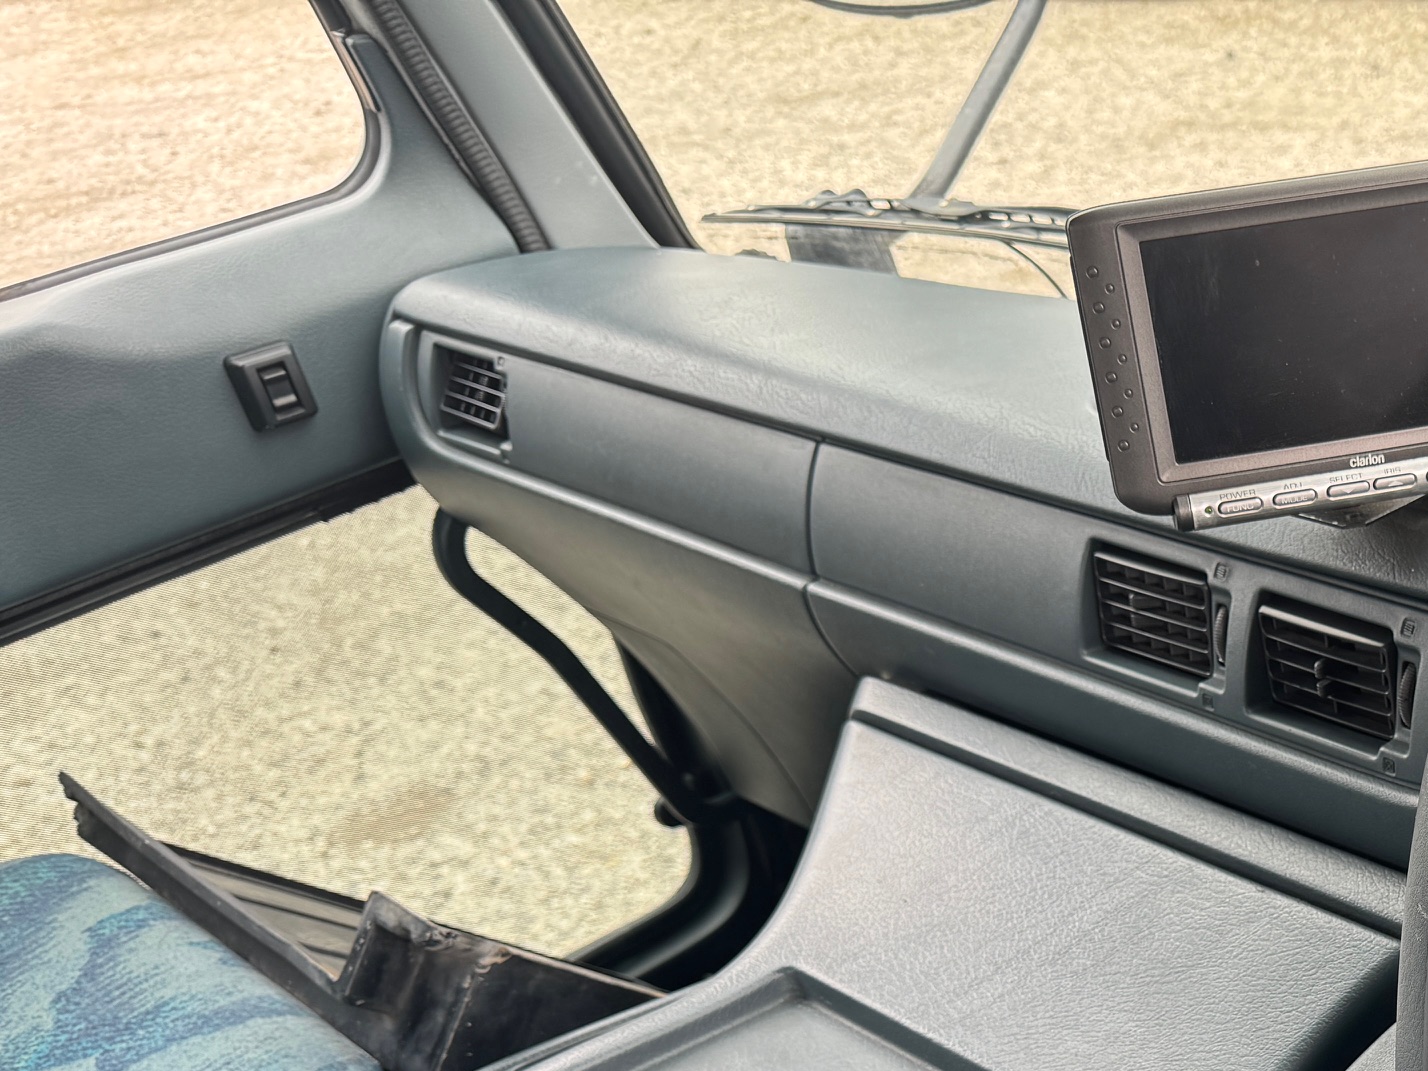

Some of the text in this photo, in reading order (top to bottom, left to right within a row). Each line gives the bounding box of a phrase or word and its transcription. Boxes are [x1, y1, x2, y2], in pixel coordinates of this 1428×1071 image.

[1349, 454, 1386, 468] clarion
[1329, 472, 1363, 484] SELECT
[1219, 488, 1257, 501] POWER
[1226, 503, 1255, 513] FUNC
